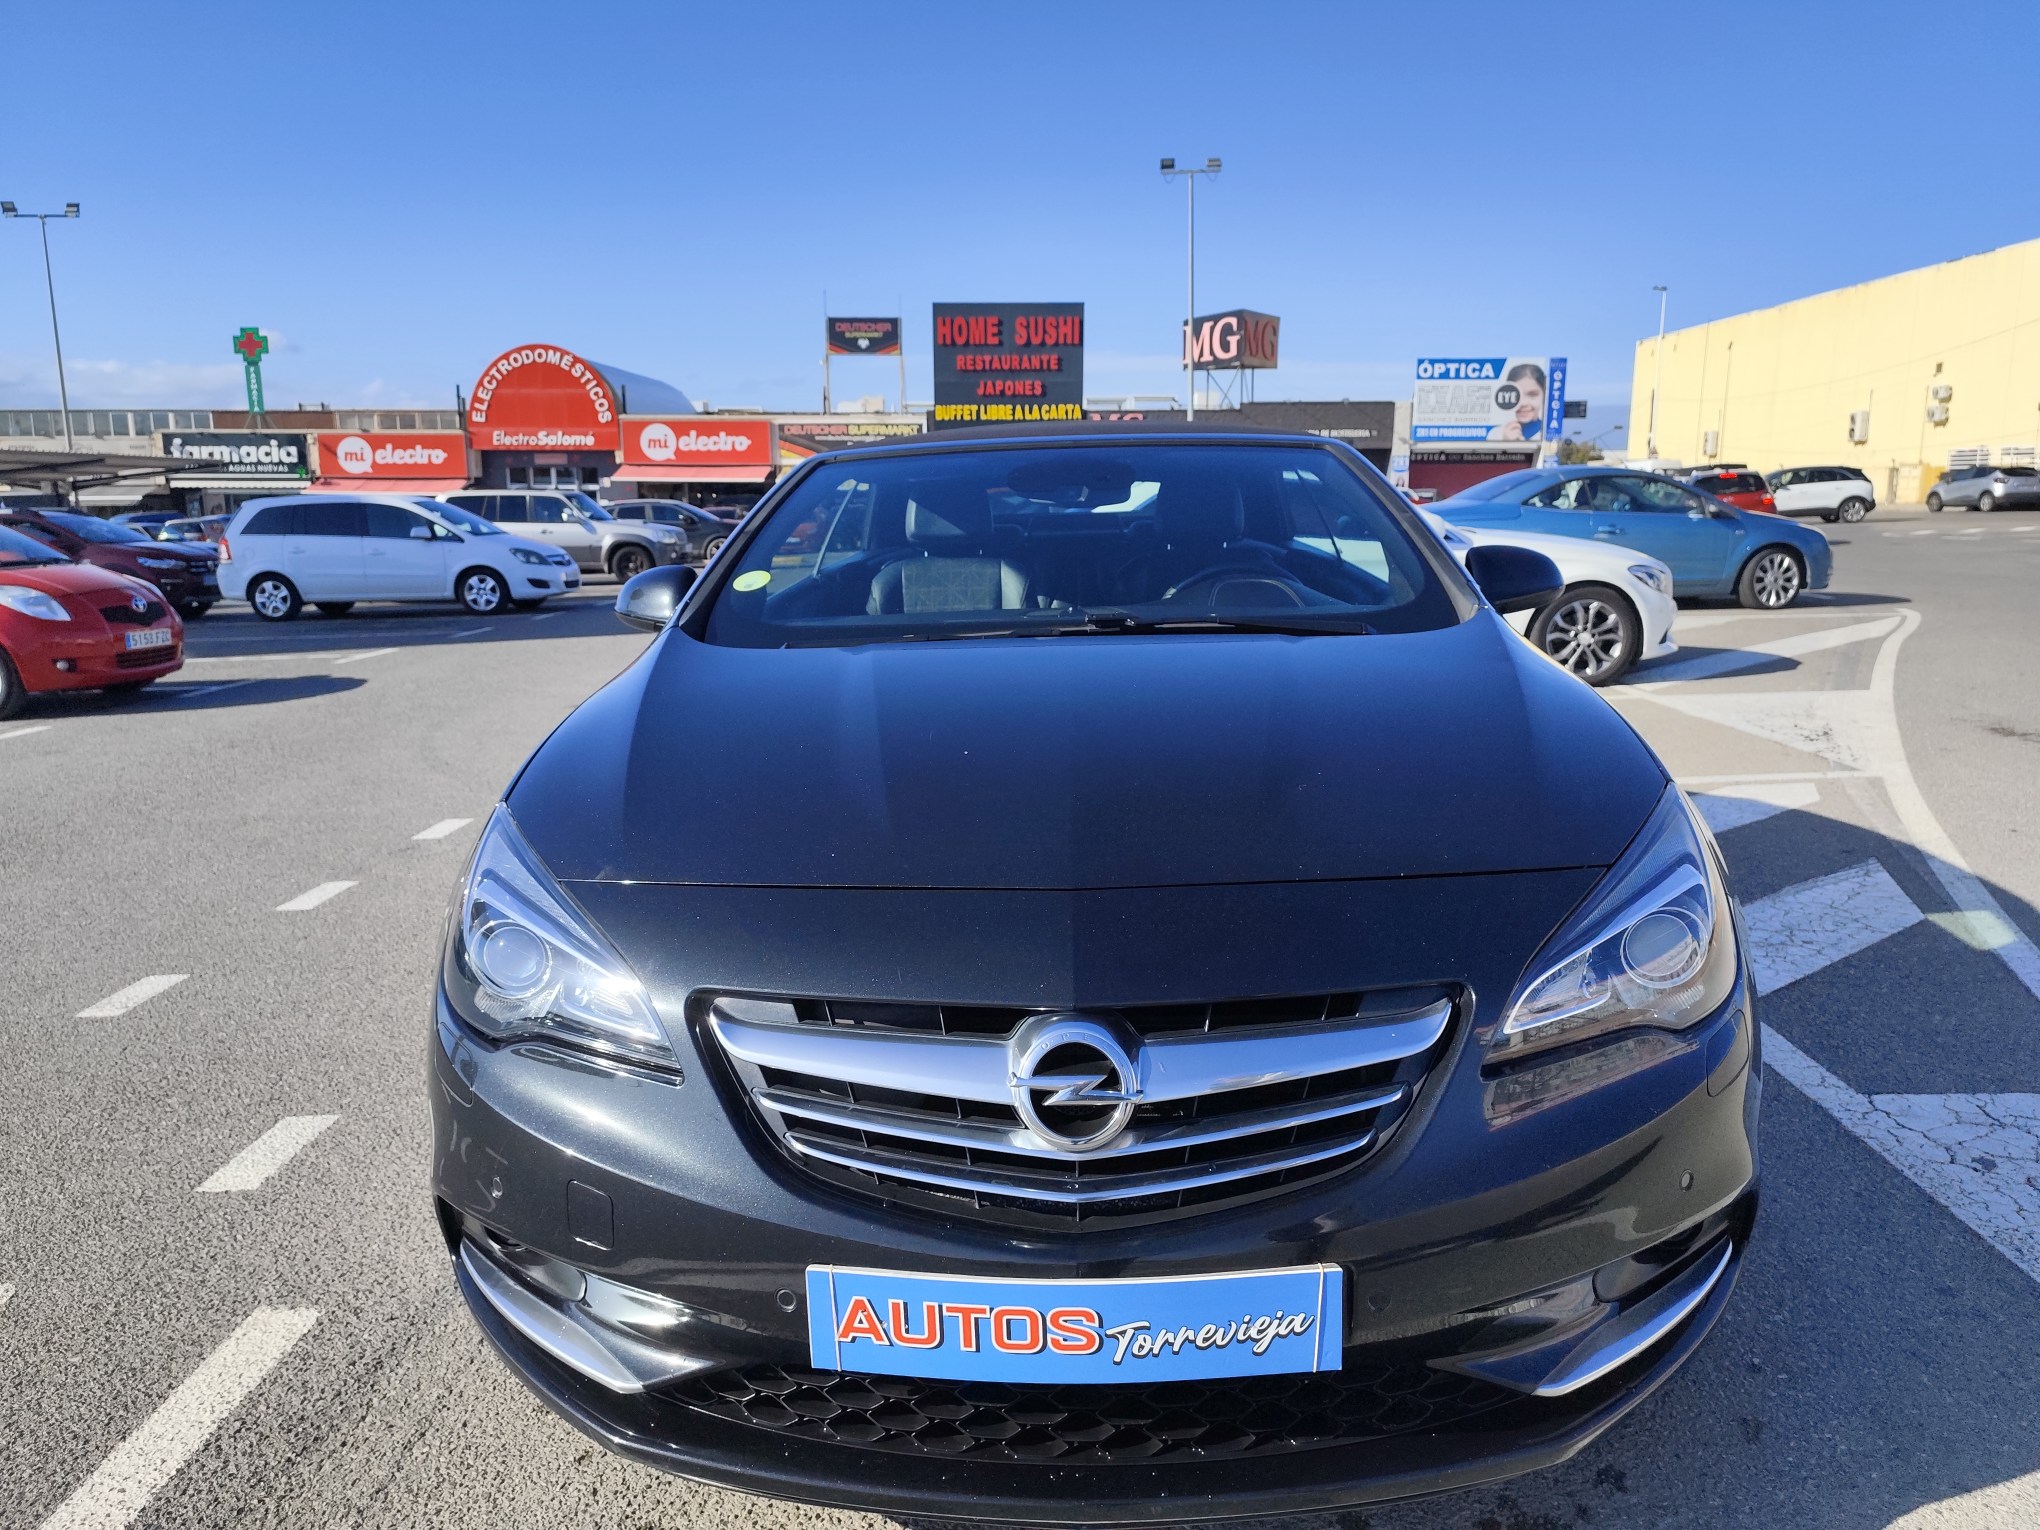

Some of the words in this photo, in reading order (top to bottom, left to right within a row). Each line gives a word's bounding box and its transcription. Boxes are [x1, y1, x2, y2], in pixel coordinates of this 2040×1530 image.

[936, 316, 1000, 346] HOME
[1014, 316, 1080, 346] SUSHI
[1183, 316, 1240, 365] MG
[956, 354, 1059, 371] RESTAURANTE
[1418, 360, 1495, 378] ÓPTICA
[472, 348, 612, 424] ELECTRODOMÉSTICOS
[976, 379, 1043, 396] JAPONES
[935, 404, 978, 421] BUFFET
[979, 404, 1013, 421] LIBRE
[1014, 404, 1024, 421] A
[1024, 404, 1041, 421] LA
[1040, 404, 1082, 421] CARTA
[492, 430, 596, 446] ElectroSalomé
[648, 435, 670, 449] mi
[678, 430, 751, 451] electro
[784, 425, 847, 435] DEUTSCHER
[848, 425, 919, 435] SUPERMARKT
[171, 437, 299, 463] farmacia
[344, 447, 366, 462] mi
[374, 442, 448, 464] electro
[838, 1295, 1103, 1355] AUTOS
[1105, 1309, 1316, 1366] Torrevieja
